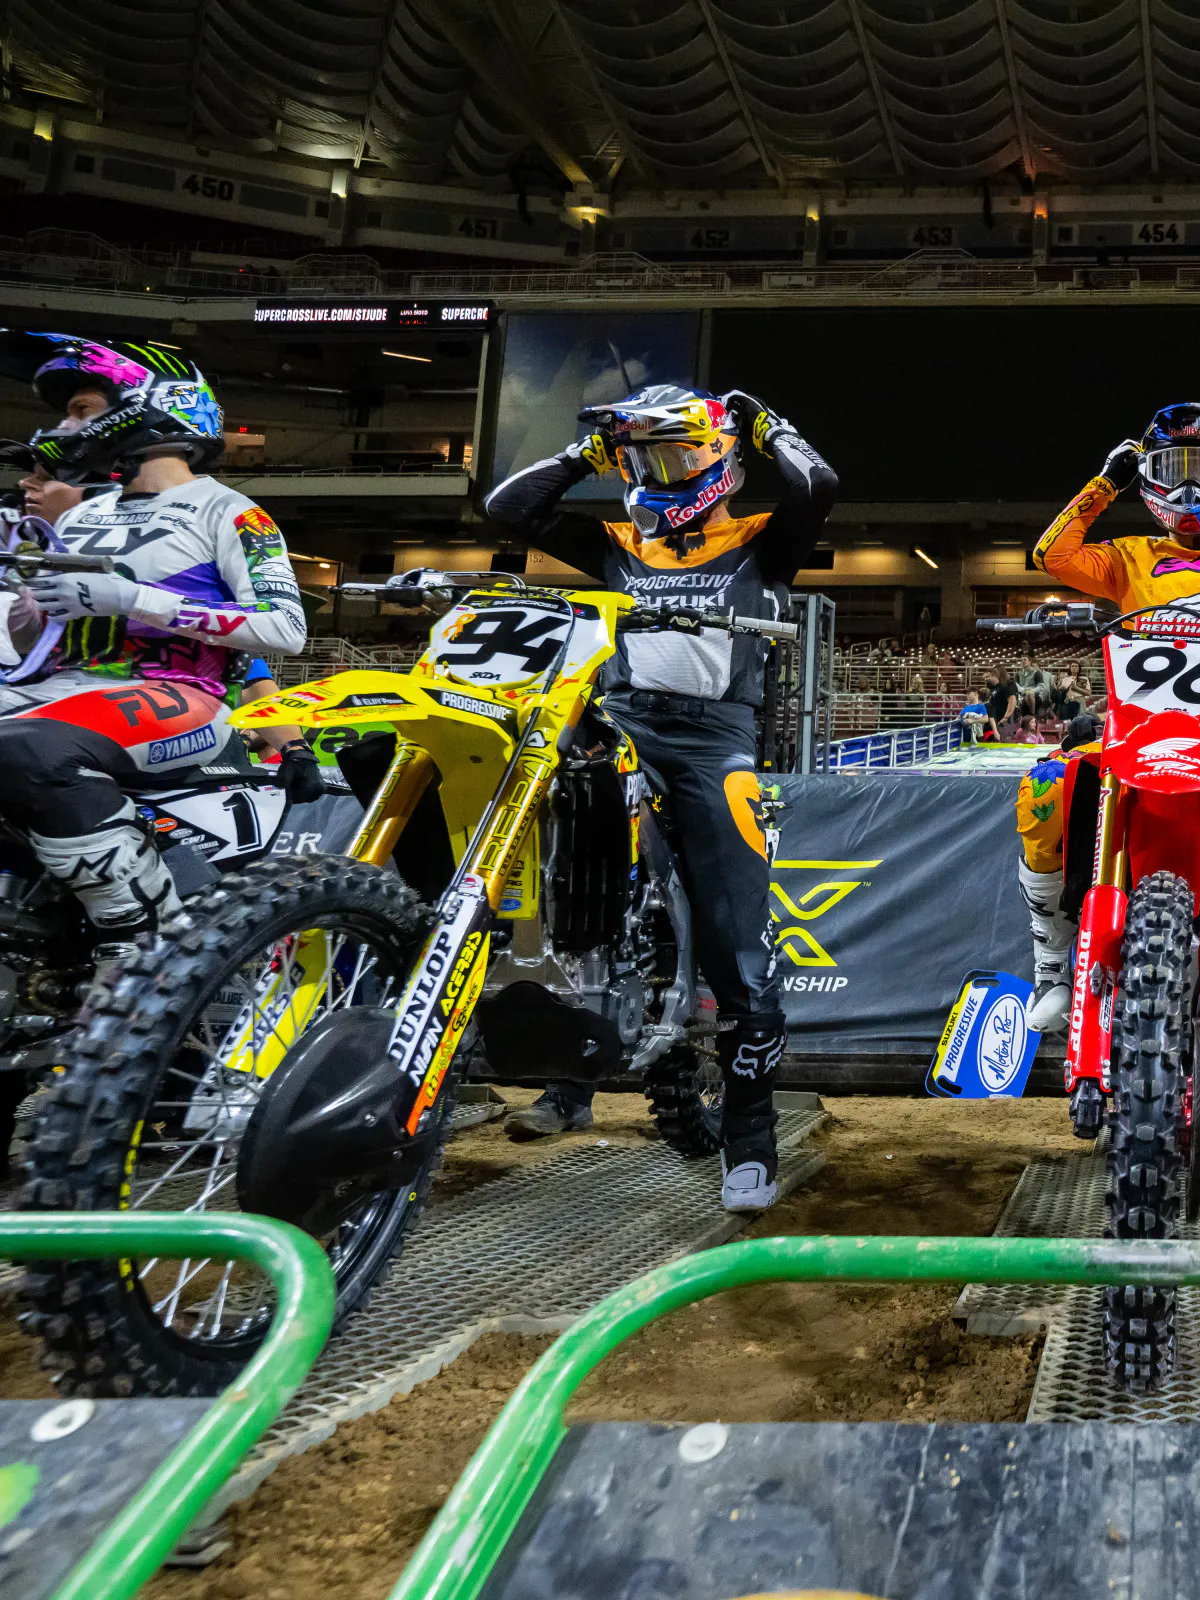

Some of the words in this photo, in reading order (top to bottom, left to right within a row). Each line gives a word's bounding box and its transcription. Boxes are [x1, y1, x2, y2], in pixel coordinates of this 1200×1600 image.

[182, 174, 234, 201] 450
[458, 218, 497, 239] 451
[691, 229, 730, 248] 452
[914, 227, 952, 246] 453
[1138, 224, 1179, 244] 454
[160, 394, 199, 413] FLY
[664, 492, 707, 529] Red
[700, 467, 736, 506] Bull
[99, 512, 153, 525] YAMAHA
[62, 526, 176, 556] FLY
[625, 573, 736, 591] PROGRESSIVE
[633, 590, 726, 609] SUZUKI
[669, 615, 699, 628] ASV
[728, 625, 750, 634] ASV
[437, 610, 572, 674] 94
[103, 681, 189, 727] FLY
[441, 691, 507, 721] PROGRESSIVE
[164, 727, 215, 759] YAMAHA
[200, 766, 239, 775] YAMAHA
[222, 790, 265, 852] 1
[388, 931, 452, 1073] DUNLOP
[1073, 929, 1092, 1051] DUNLOP
[942, 1012, 958, 1047] SUZUKI
[945, 996, 978, 1071] PROGRESSIVE
[993, 1005, 1012, 1035] Pro
[983, 1036, 1012, 1081] Motion
